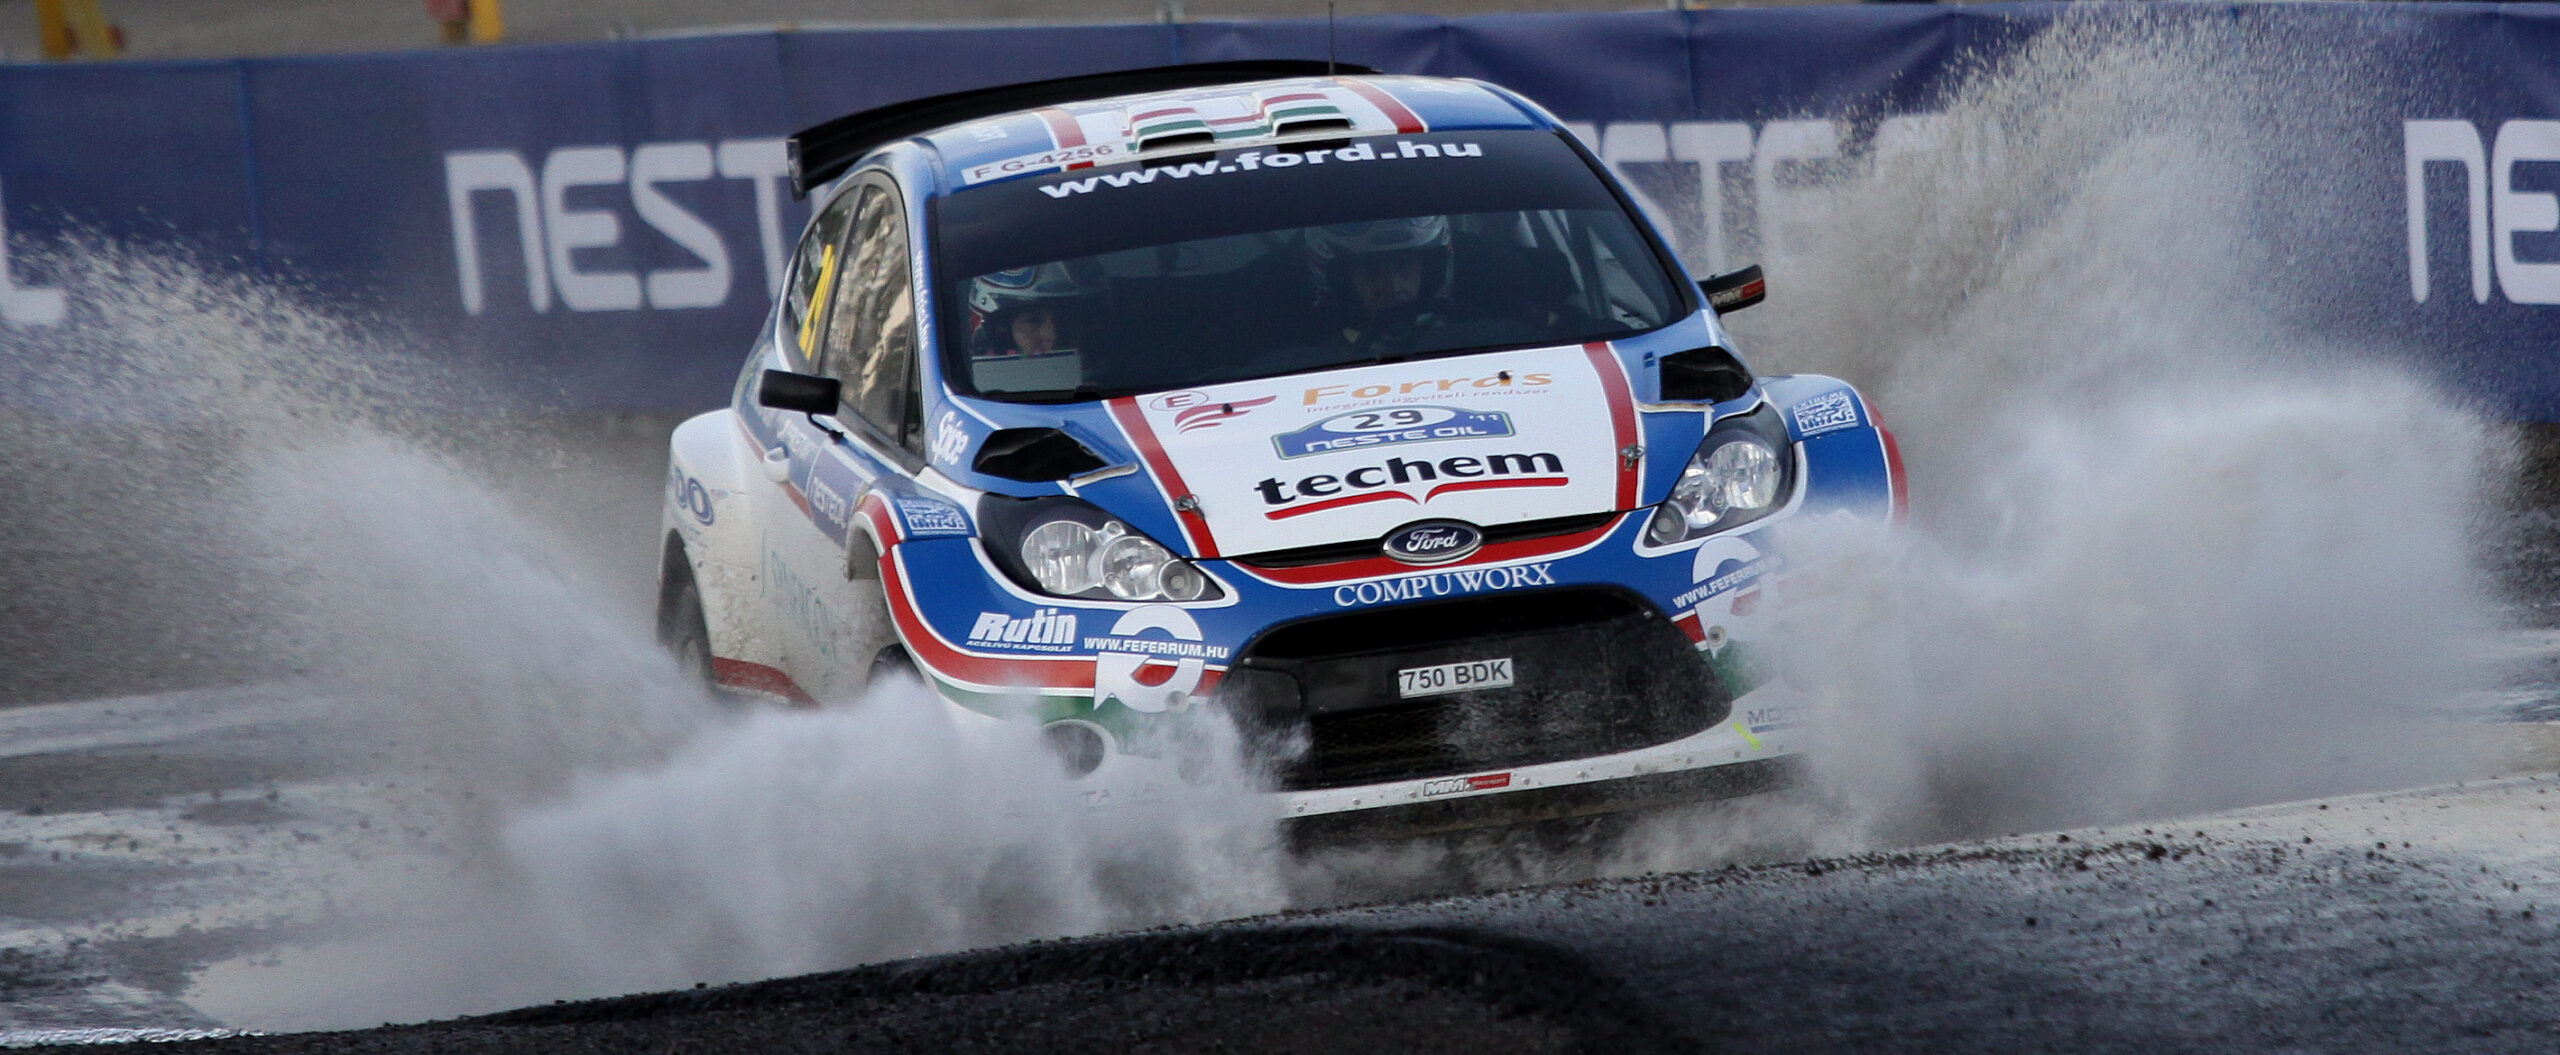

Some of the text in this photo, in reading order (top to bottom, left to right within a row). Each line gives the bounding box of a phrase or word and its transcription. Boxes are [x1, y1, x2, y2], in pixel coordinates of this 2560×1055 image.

[1001, 145, 1113, 173] G-4256
[1039, 140, 1483, 199] www.ford.hu
[1351, 409, 1423, 431] 29
[1306, 425, 1488, 453] NESTE OIL
[1253, 451, 1564, 506] techem
[1406, 528, 1459, 555] Ford
[1333, 562, 1556, 607] COMPUWORX
[968, 608, 1077, 644] Rutin
[1084, 637, 1230, 659] WWW.FEFERRUM.HU
[1404, 660, 1509, 691] 750 BDK
